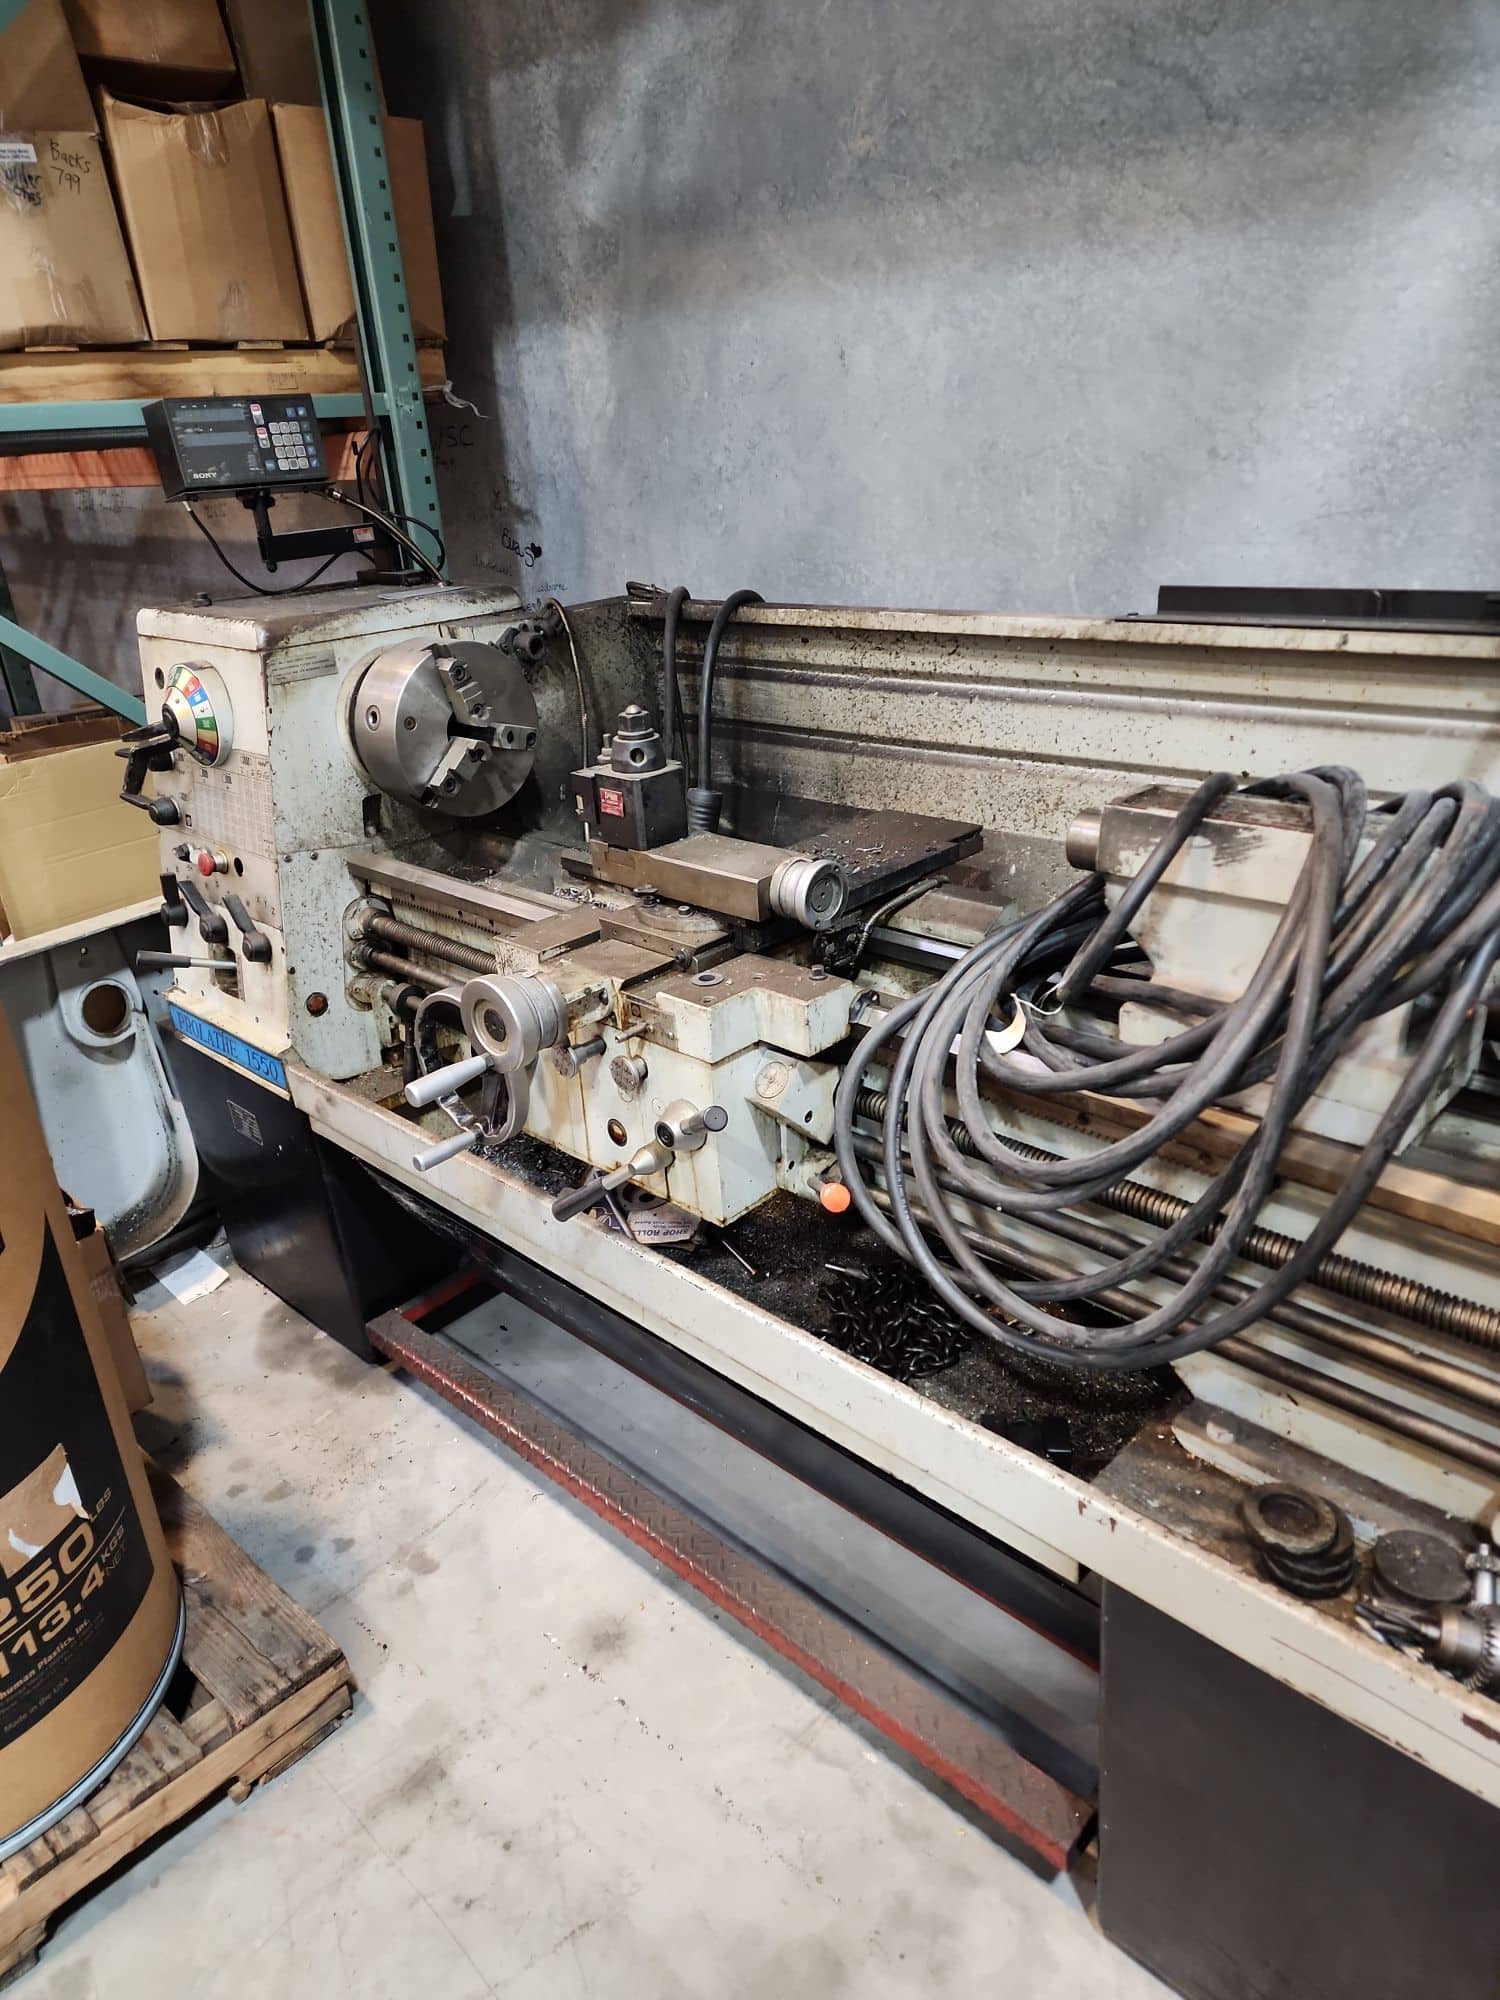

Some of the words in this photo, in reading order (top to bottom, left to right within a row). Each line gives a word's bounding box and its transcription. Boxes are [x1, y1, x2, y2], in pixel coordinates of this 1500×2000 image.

[49, 138, 92, 174] Backs
[50, 165, 81, 196] 799
[177, 1011, 238, 1059] PROLATHE
[246, 1048, 279, 1082] 1550
[663, 1228, 689, 1236] SHOP
[89, 1487, 112, 1522] LBS
[101, 1524, 125, 1563] KGS
